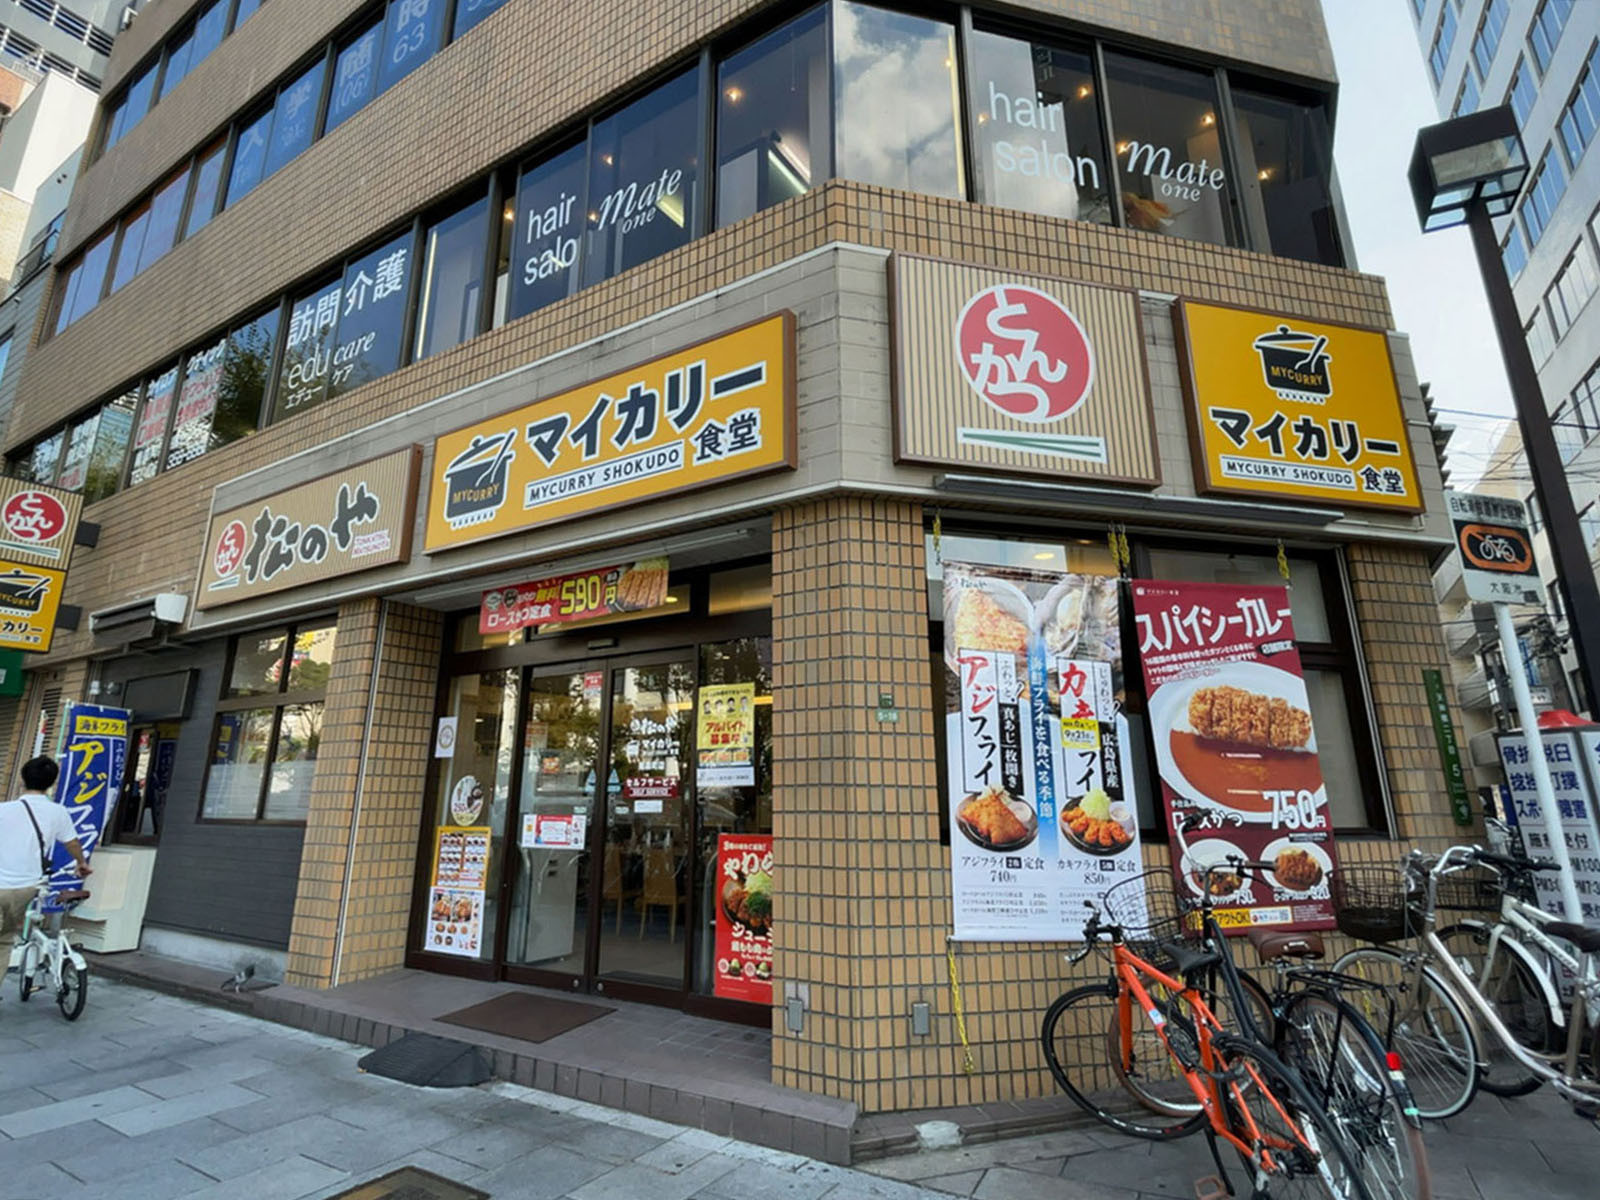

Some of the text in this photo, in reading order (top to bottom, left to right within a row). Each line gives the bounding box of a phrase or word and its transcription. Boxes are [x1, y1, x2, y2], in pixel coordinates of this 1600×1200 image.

[392, 22, 426, 64] 63
[989, 80, 1061, 133] hair
[994, 139, 1100, 190] salon
[1161, 181, 1201, 202] one
[526, 192, 576, 244] hair
[622, 206, 656, 235] one
[286, 248, 408, 350] 訪問介護
[333, 331, 376, 366] care
[957, 284, 1095, 424] とんかつ
[1271, 366, 1323, 387] MYCURRY
[525, 359, 766, 466] マイカリー
[693, 409, 761, 464] 食堂
[1209, 407, 1400, 464] マイカリー
[529, 448, 680, 502] MYCURRY SHOKUDO
[1226, 460, 1353, 486] MYCURRY SHOKUDO
[1360, 466, 1406, 495] 食堂
[452, 482, 500, 504] MYCURRY
[243, 481, 380, 584] 松のや
[561, 575, 600, 614] 590
[487, 604, 551, 627] ロースかつ定食
[1135, 598, 1292, 653] スパイシーカレー
[705, 721, 745, 733] アルバイト
[957, 656, 997, 784] アジフライ
[626, 778, 677, 787] セルフサービス
[1171, 810, 1244, 830] ロスかつ
[961, 856, 1004, 868] アジフライ
[1024, 856, 1045, 870] 定食
[1057, 859, 1098, 871] カキフライ
[1116, 859, 1136, 872] 定食
